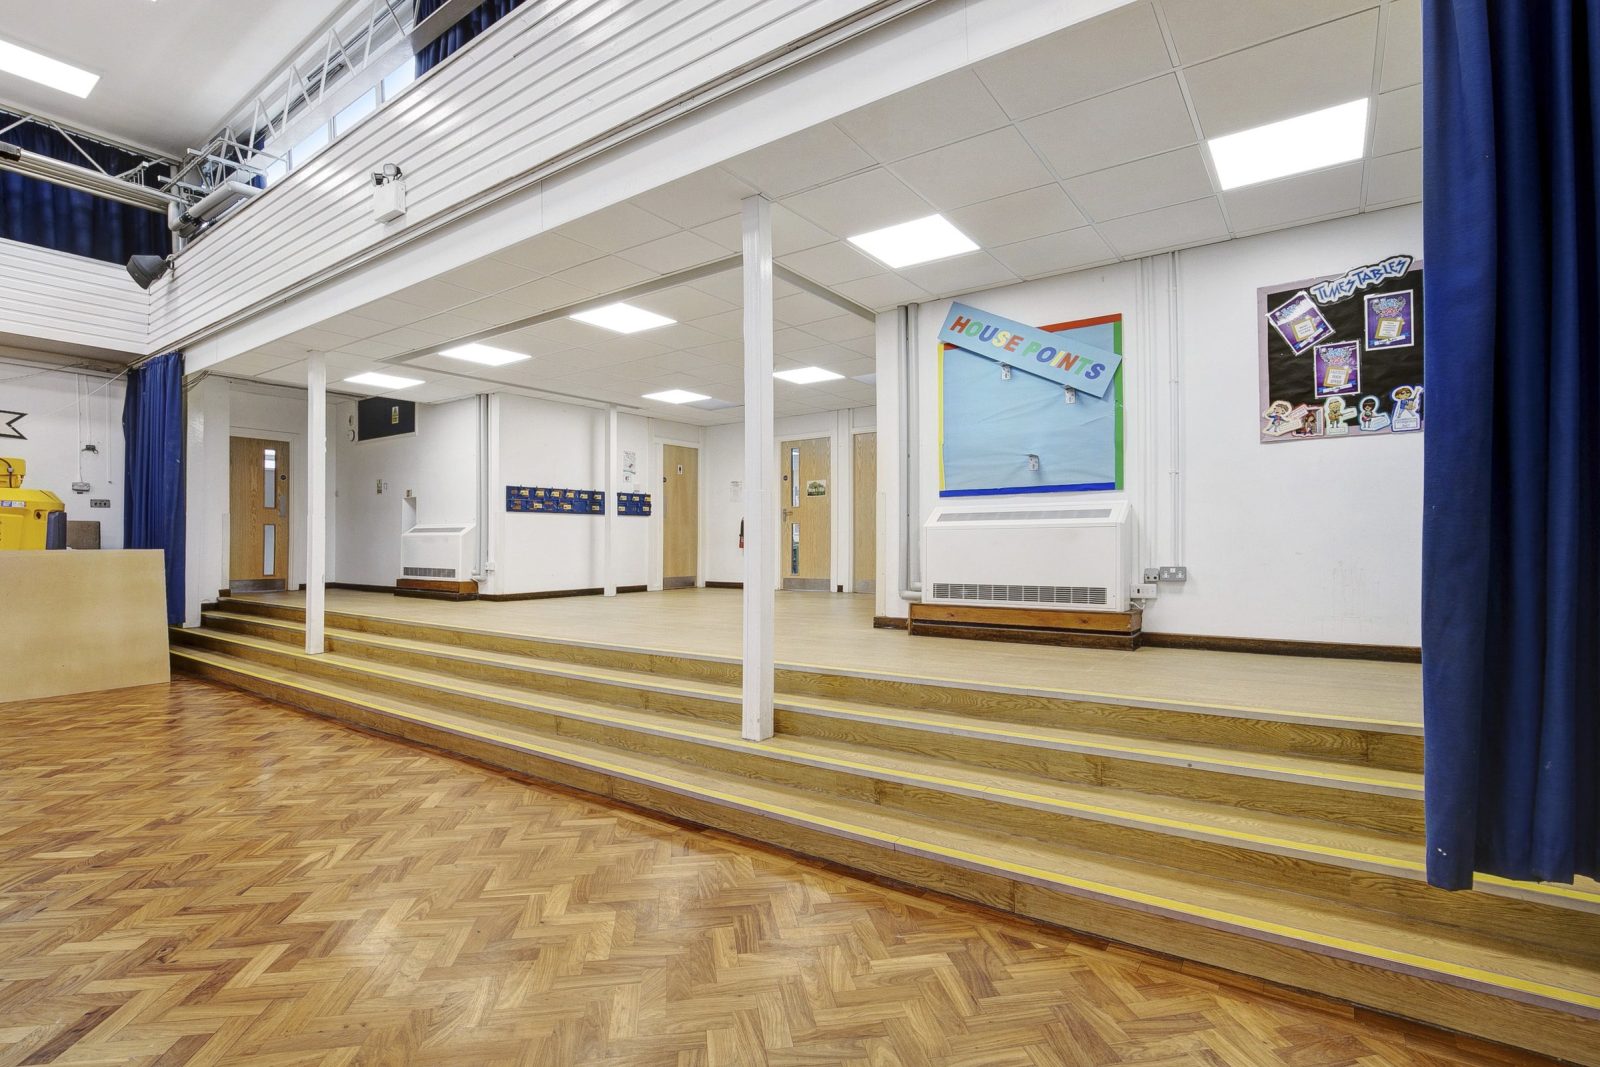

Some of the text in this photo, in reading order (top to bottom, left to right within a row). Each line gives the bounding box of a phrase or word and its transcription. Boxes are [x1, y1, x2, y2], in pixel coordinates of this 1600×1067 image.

[1313, 259, 1407, 300] TIMES TABLES
[950, 315, 1106, 380] HOUSE POINTS
